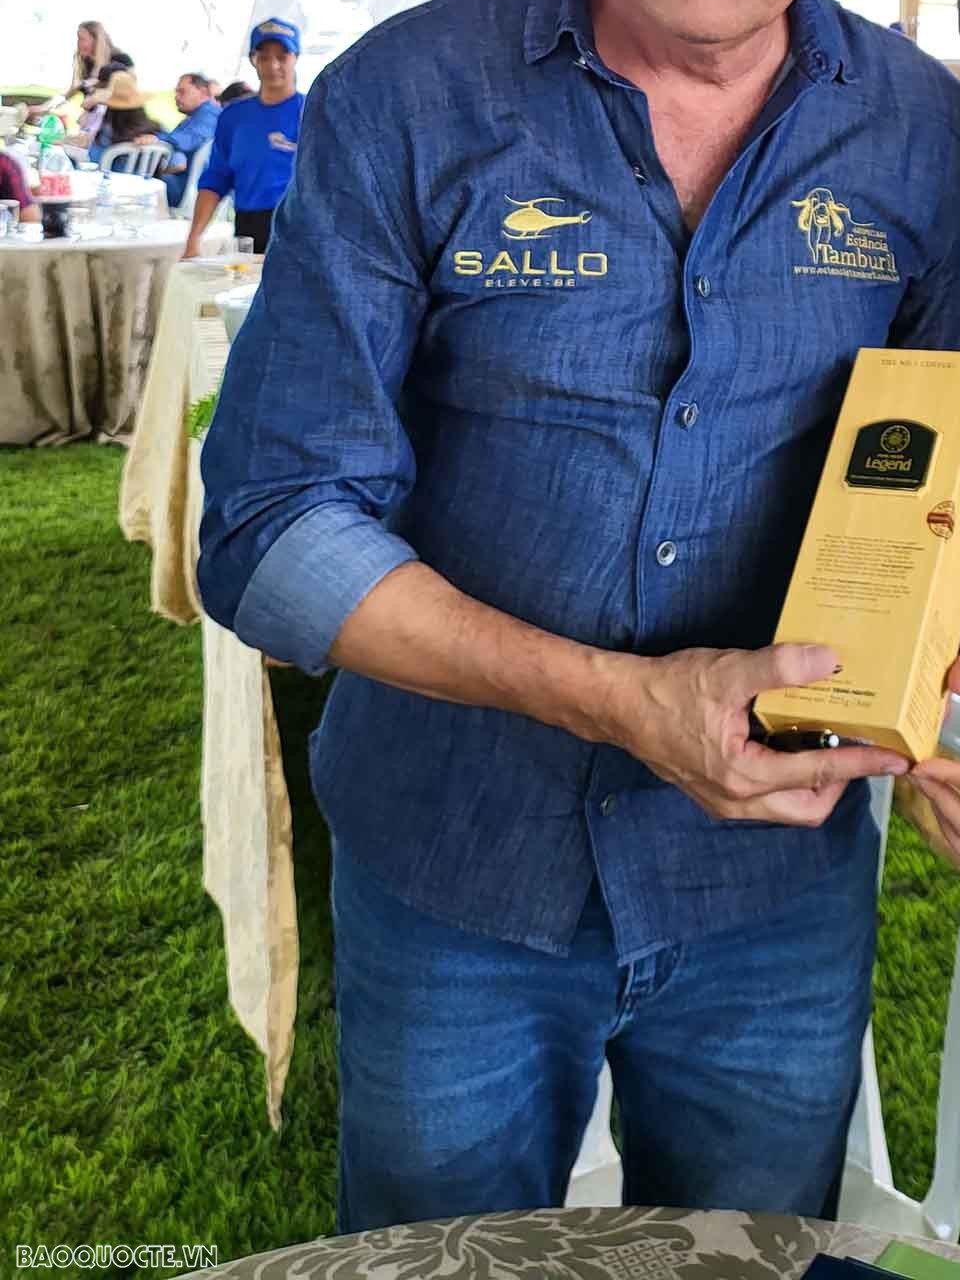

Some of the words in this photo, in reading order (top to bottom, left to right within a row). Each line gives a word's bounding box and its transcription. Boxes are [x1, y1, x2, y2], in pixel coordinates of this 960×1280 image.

[453, 250, 609, 276] SALLO
[816, 243, 896, 273] Tamburil
[864, 455, 912, 472] Legend
